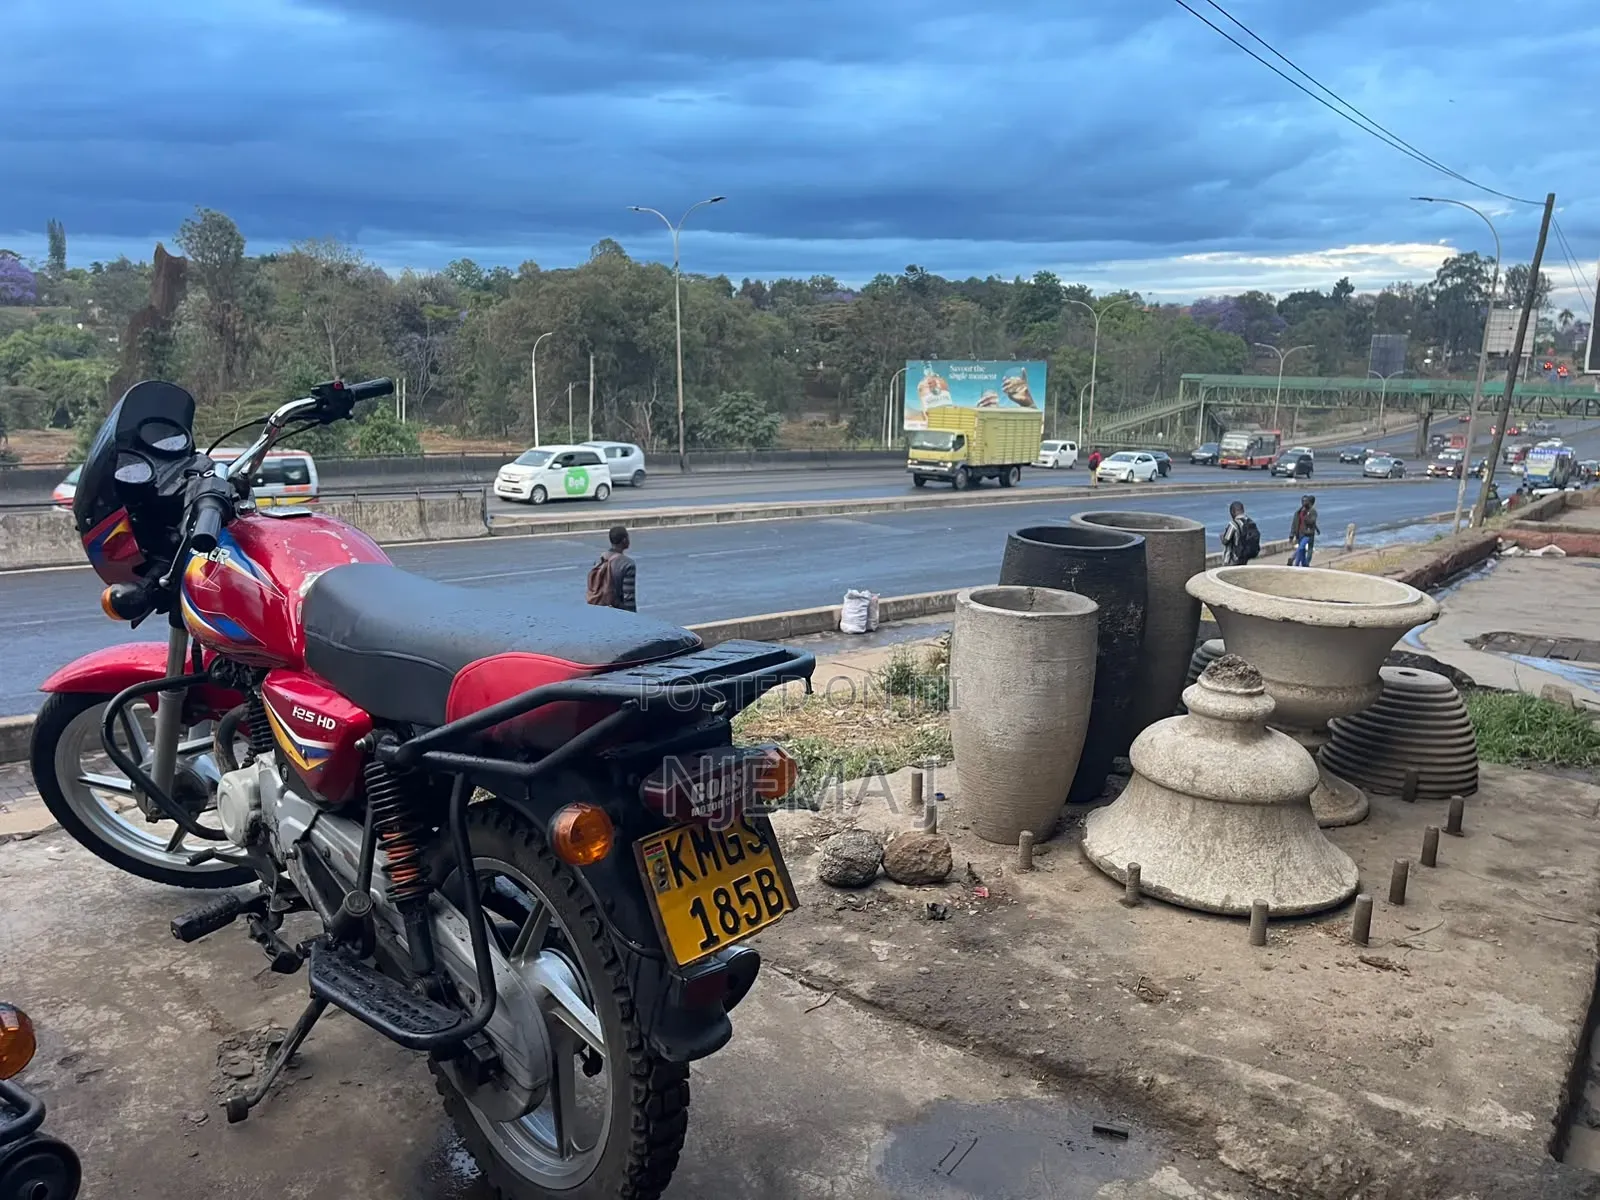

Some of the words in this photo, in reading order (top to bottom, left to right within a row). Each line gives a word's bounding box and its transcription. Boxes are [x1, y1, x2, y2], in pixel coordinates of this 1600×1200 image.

[974, 364, 986, 372] the
[292, 705, 316, 722] 125
[316, 715, 336, 730] HD
[690, 867, 784, 950] 185B
